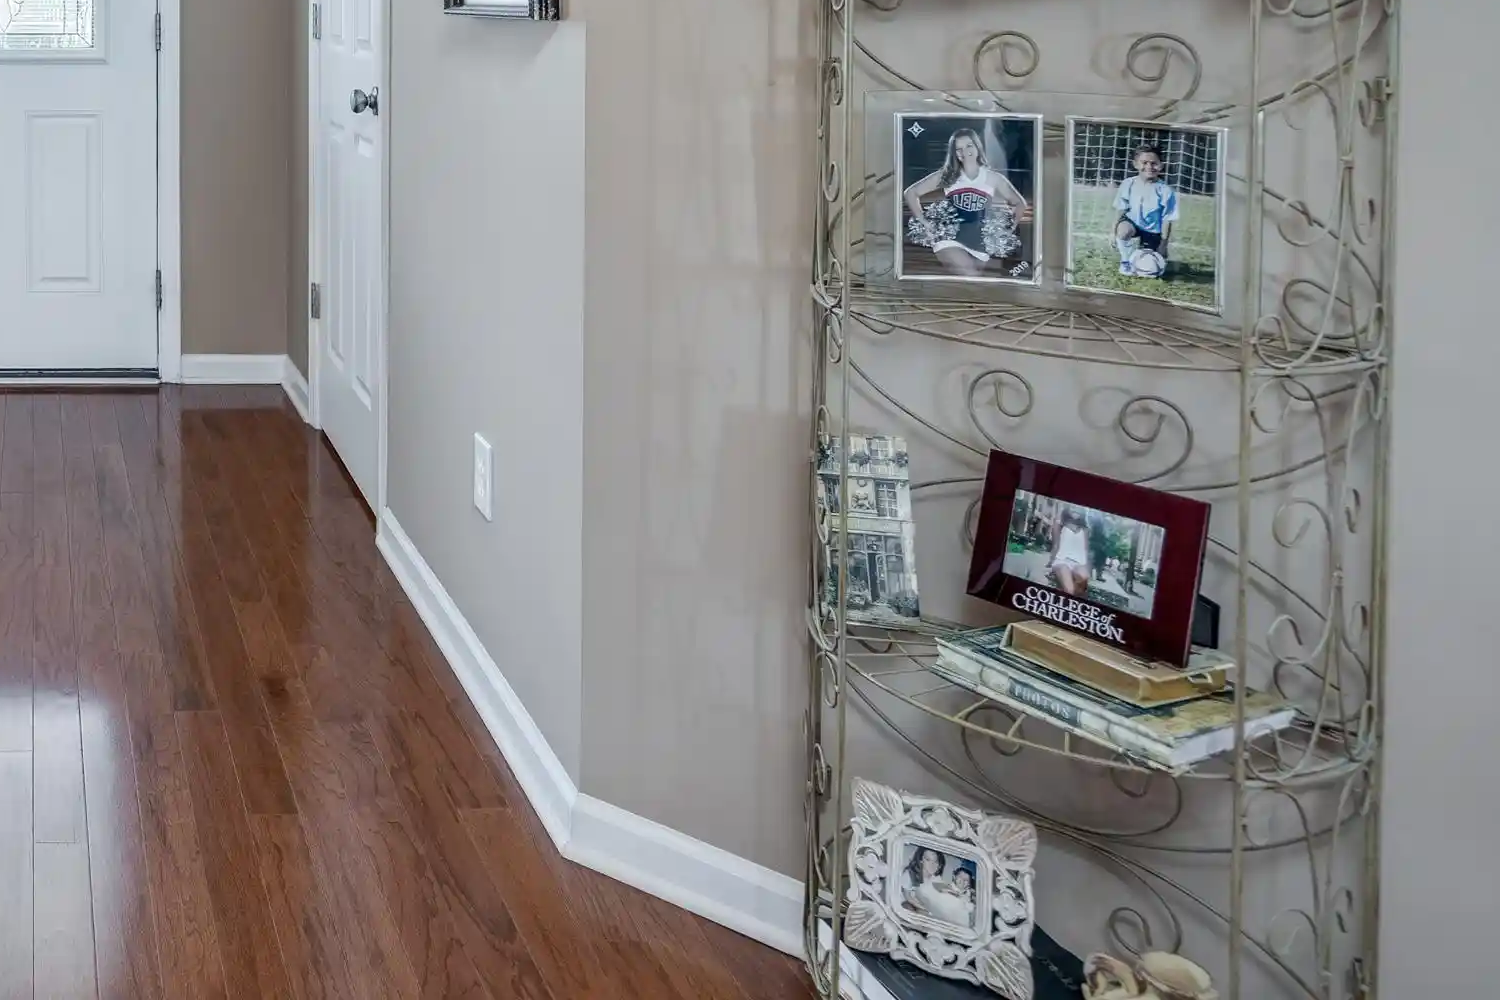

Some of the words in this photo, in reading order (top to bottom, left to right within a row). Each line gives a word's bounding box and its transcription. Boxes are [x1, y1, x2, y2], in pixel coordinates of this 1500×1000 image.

[1026, 585, 1101, 621] COLLEGE
[1100, 613, 1118, 627] of
[1014, 684, 1070, 719] PHOTOS
